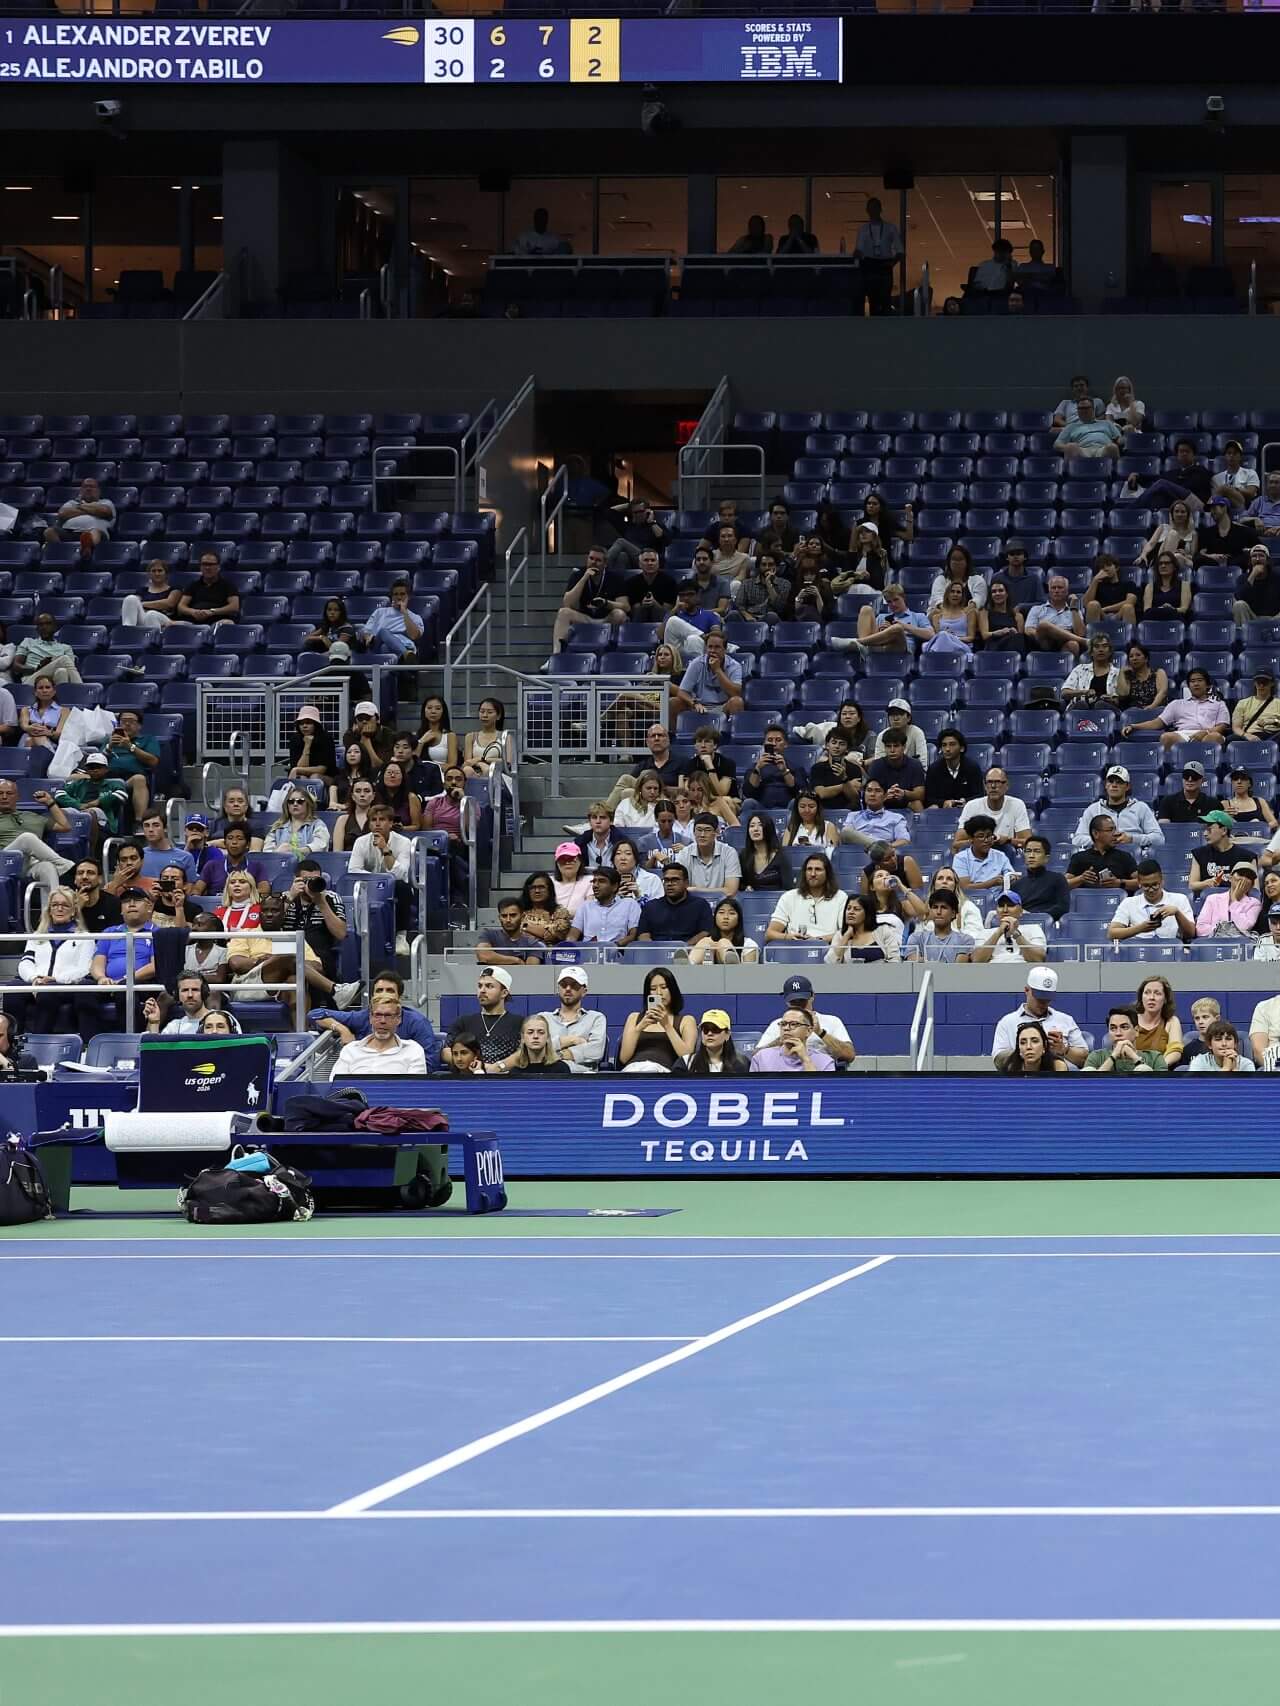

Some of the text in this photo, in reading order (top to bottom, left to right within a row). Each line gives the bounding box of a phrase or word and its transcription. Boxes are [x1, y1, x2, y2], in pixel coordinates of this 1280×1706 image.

[5, 24, 602, 46] 1 ALEXANDER ZVEREV 30 6 7 2
[745, 23, 812, 32] SCORES & STATS
[752, 33, 805, 43] POWERED BY
[0, 57, 602, 79] 25 ALEJANDRO TABILO 30 2 6 2
[740, 45, 817, 78] IBM
[184, 1076, 222, 1087] us open
[602, 1091, 847, 1129] DOBEL
[640, 1140, 809, 1162] TEQUILA
[475, 1149, 504, 1187] POLO
